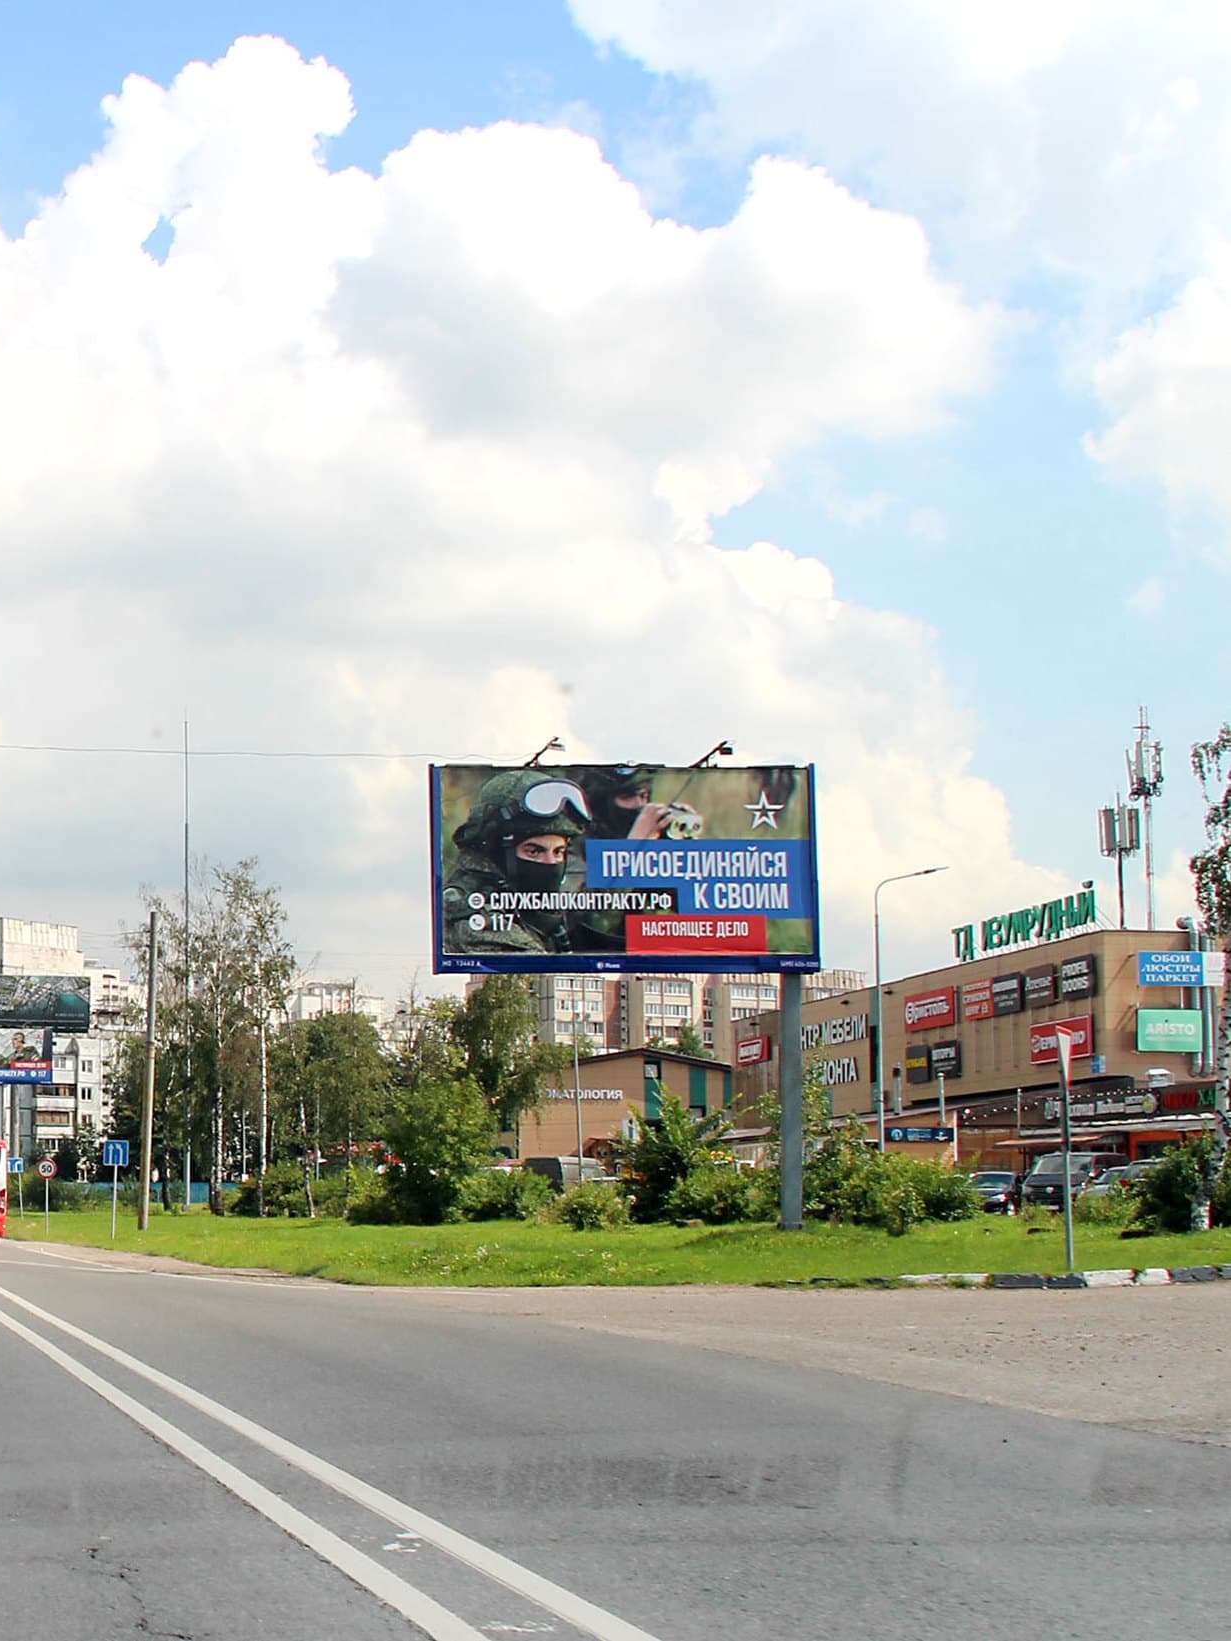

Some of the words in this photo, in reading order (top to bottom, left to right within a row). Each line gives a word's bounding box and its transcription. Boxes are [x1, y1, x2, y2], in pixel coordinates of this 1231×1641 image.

[602, 846, 787, 880] ПРИСОЕДИНЯЙСЯ
[490, 892, 672, 910] СЛУЖБАПОКОНТРАКТУ.РФ
[694, 883, 709, 909] К
[714, 883, 789, 909] СВОИМ
[642, 921, 714, 937] НАСТОЯЩЕЕ
[716, 921, 749, 938] ДЕЛО
[1151, 954, 1191, 963] ОБОИ
[1141, 964, 1202, 973] ЛЮСТРЫ
[1145, 974, 1198, 982] ПАРКЕТ
[821, 1014, 868, 1046] МЕБЕЛИ
[41, 1164, 53, 1174] 50
